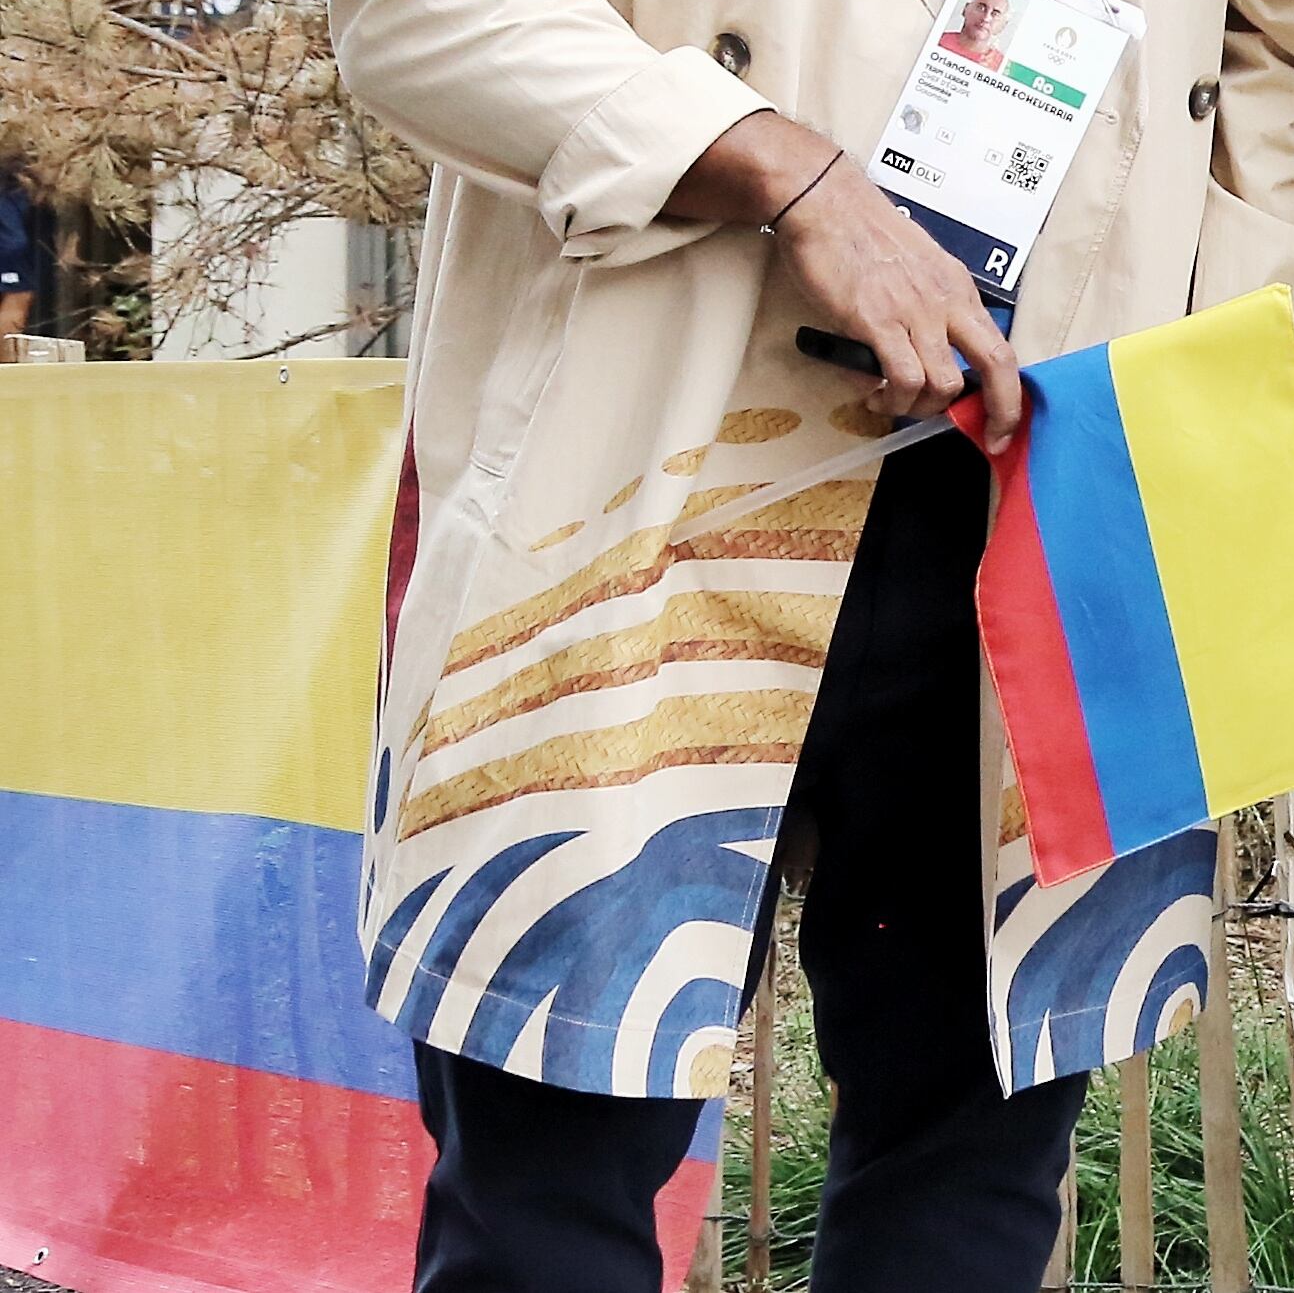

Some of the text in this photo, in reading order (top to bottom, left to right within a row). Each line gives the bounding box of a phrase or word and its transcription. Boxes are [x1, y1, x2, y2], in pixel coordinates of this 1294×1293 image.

[930, 52, 1074, 122] Orlando IBARRA ECHEVERRIA
[883, 152, 942, 183] ATH OLV
[984, 247, 1009, 277] R
